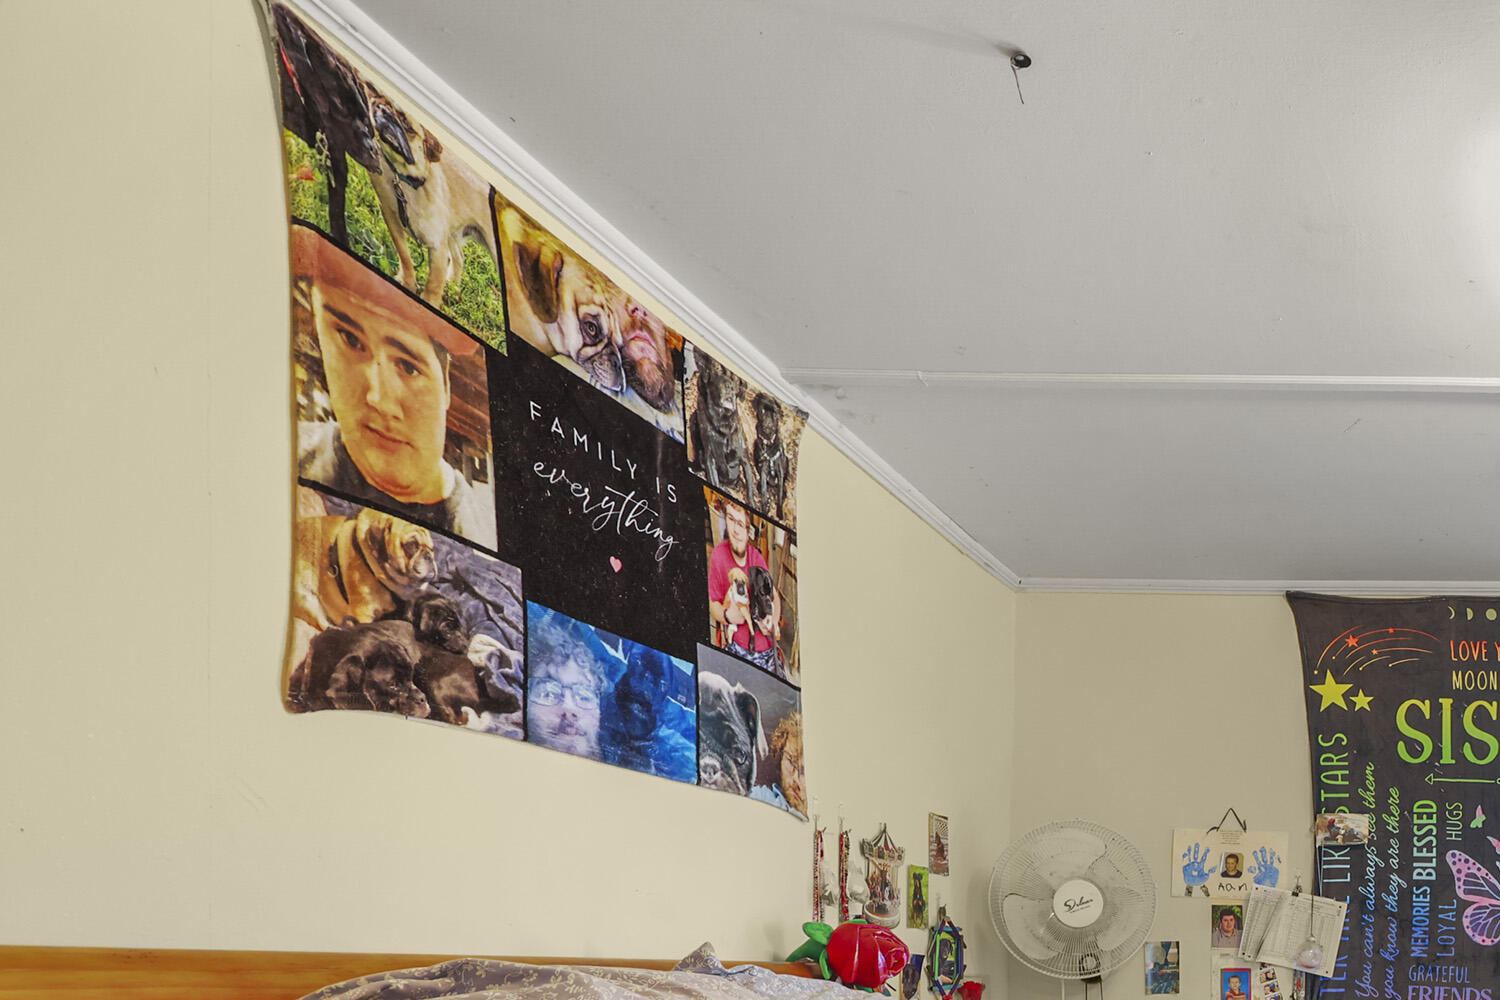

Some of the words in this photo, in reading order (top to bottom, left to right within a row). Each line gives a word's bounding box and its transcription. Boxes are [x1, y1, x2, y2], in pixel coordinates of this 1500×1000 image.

[530, 401, 636, 479] FAMILY
[656, 476, 677, 502] IS
[534, 461, 679, 561] everything
[1450, 640, 1488, 662] LOVE
[1452, 670, 1498, 691] MOON
[1358, 761, 1376, 809] them
[1382, 786, 1400, 834] there
[1446, 802, 1463, 841] HUGS
[1387, 838, 1400, 870] are
[1412, 799, 1437, 880] BLESSED
[1358, 841, 1385, 910] always
[1380, 873, 1408, 912] they
[1360, 914, 1376, 957] can't
[1379, 916, 1400, 961] know
[1410, 886, 1431, 957] MEMORIES
[1436, 899, 1457, 958] LOYAL
[1355, 960, 1380, 998] You
[1383, 964, 1401, 1000] you
[1408, 964, 1471, 984] GRATEFUL
